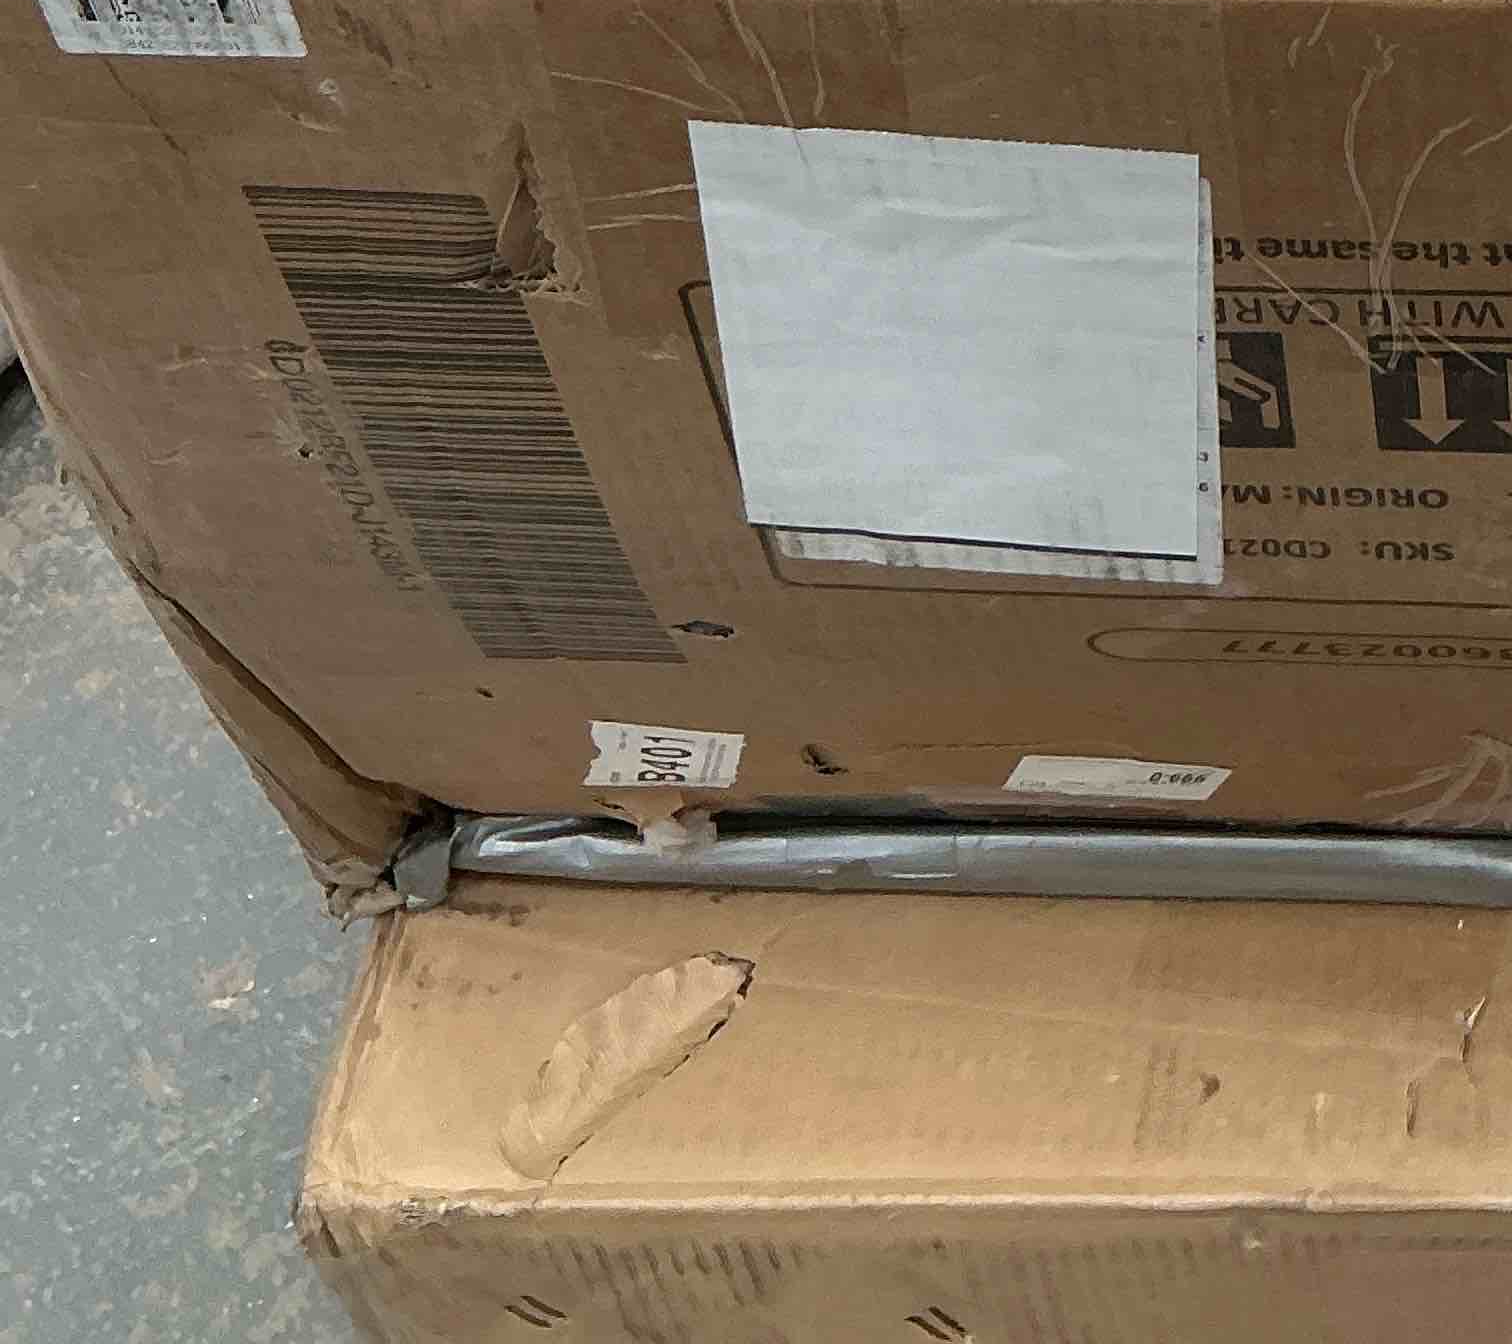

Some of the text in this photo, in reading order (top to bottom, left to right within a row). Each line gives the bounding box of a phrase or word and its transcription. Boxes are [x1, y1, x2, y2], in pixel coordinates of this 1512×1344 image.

[1257, 236, 1373, 262] same
[1390, 240, 1472, 269] the
[1357, 298, 1506, 330] WITH
[1359, 539, 1456, 562] SKU:
[637, 735, 697, 783] B401
